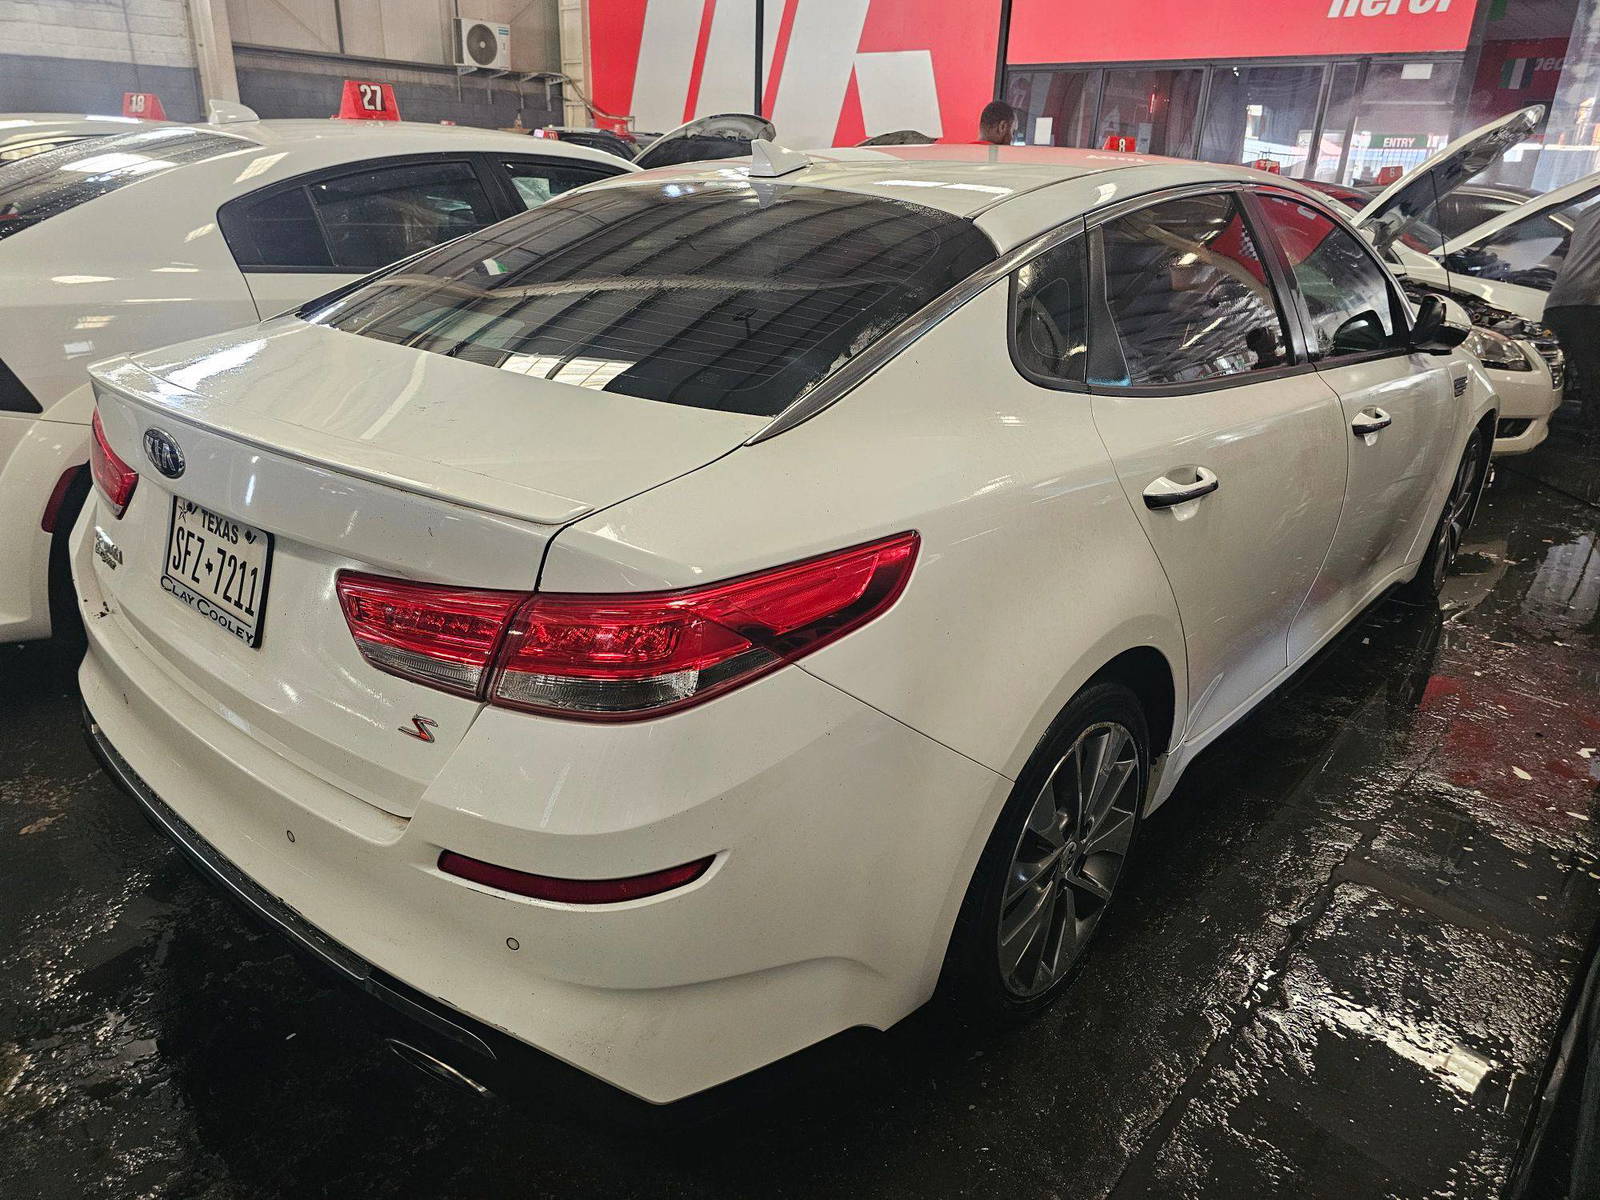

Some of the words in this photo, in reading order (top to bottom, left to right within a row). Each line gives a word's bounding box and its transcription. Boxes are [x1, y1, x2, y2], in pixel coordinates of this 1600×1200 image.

[360, 84, 382, 111] 27
[1383, 137, 1416, 148] ENTRY
[145, 433, 177, 472] KIA
[201, 508, 239, 544] TEXAS
[160, 575, 195, 606] CLAY
[197, 599, 255, 645] COOLEY
[397, 714, 439, 743] S
